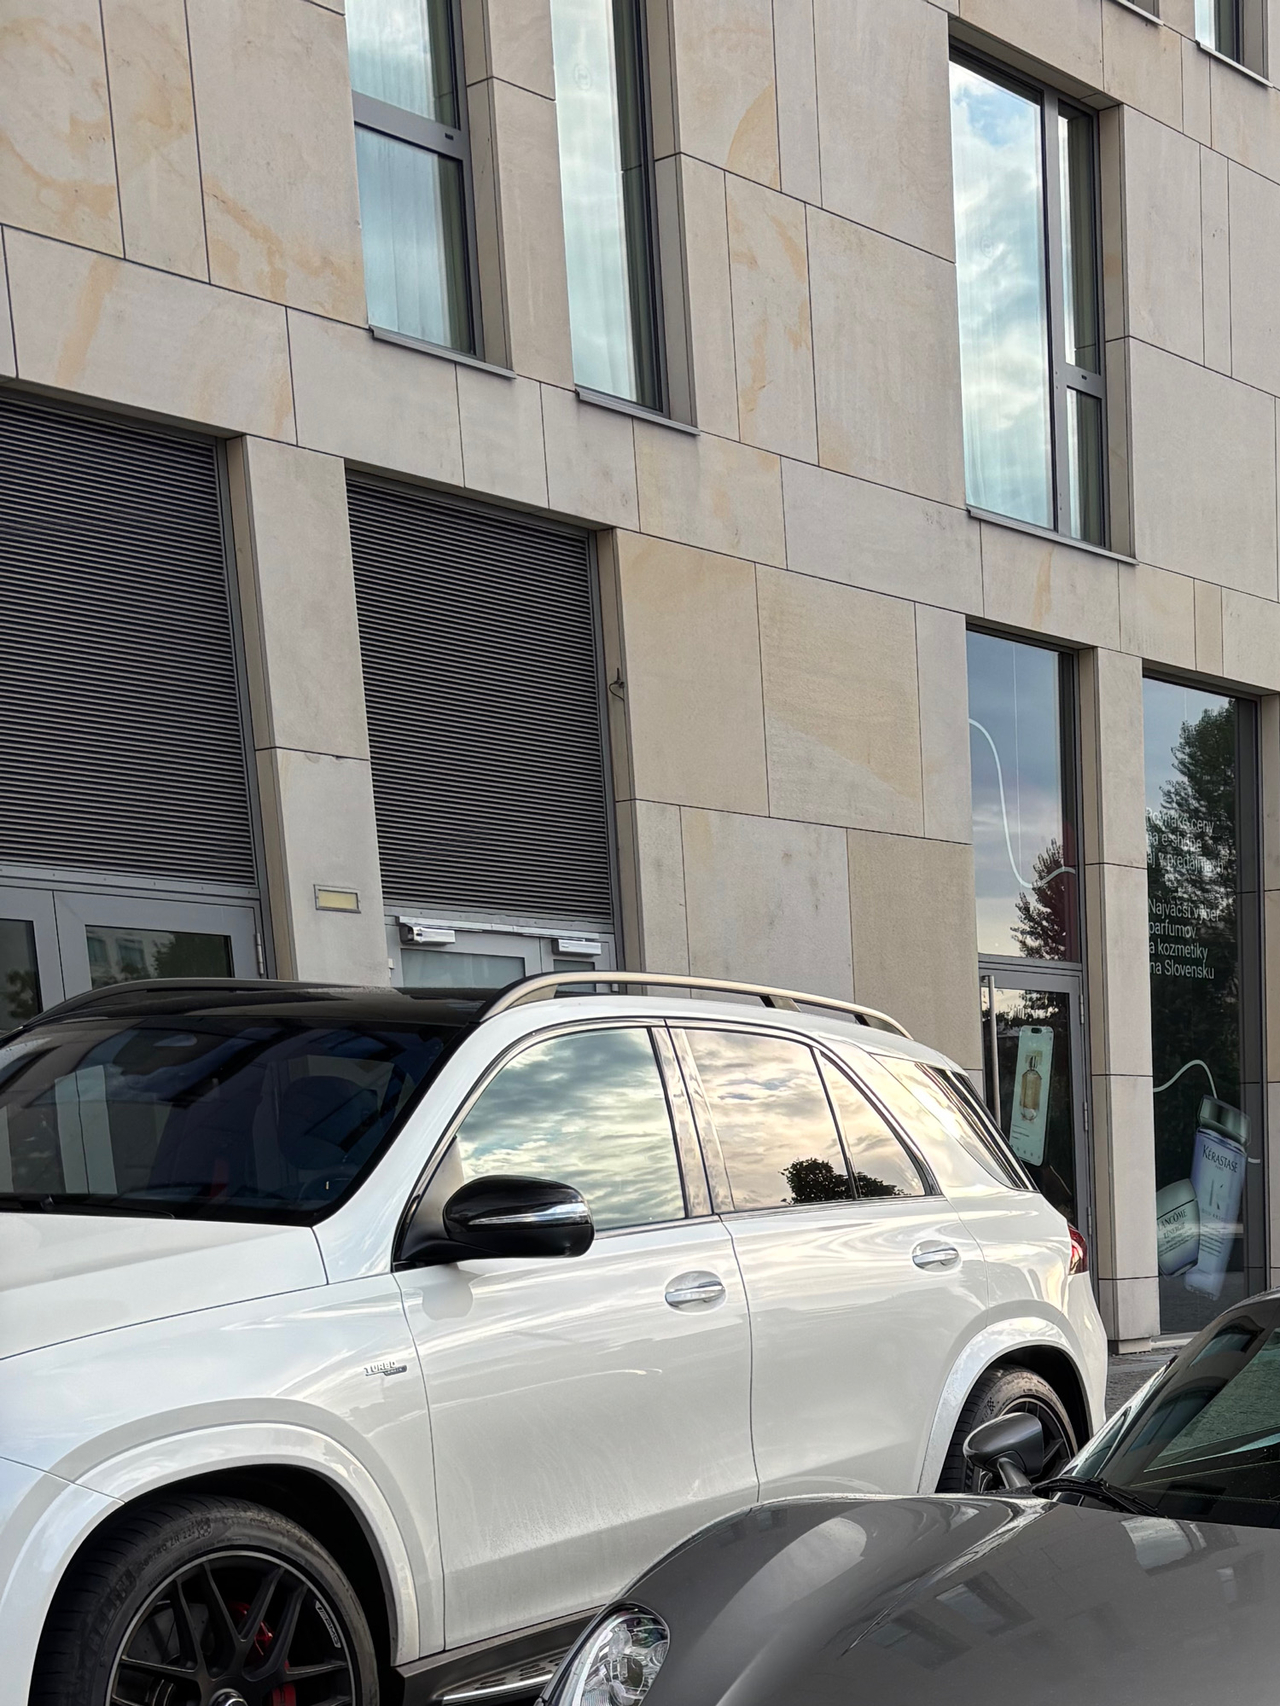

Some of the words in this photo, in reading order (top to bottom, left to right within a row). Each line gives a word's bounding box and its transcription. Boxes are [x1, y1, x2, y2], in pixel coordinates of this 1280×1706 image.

[1191, 814, 1215, 836] ceny
[1149, 920, 1196, 939] parfumov
[1149, 941, 1156, 953] a
[1157, 937, 1208, 963] kozmetiky
[1150, 961, 1162, 975] na
[1164, 960, 1215, 980] Slovensku
[1203, 1144, 1238, 1173] KÉRASTASE
[363, 1361, 397, 1374] TURBO
